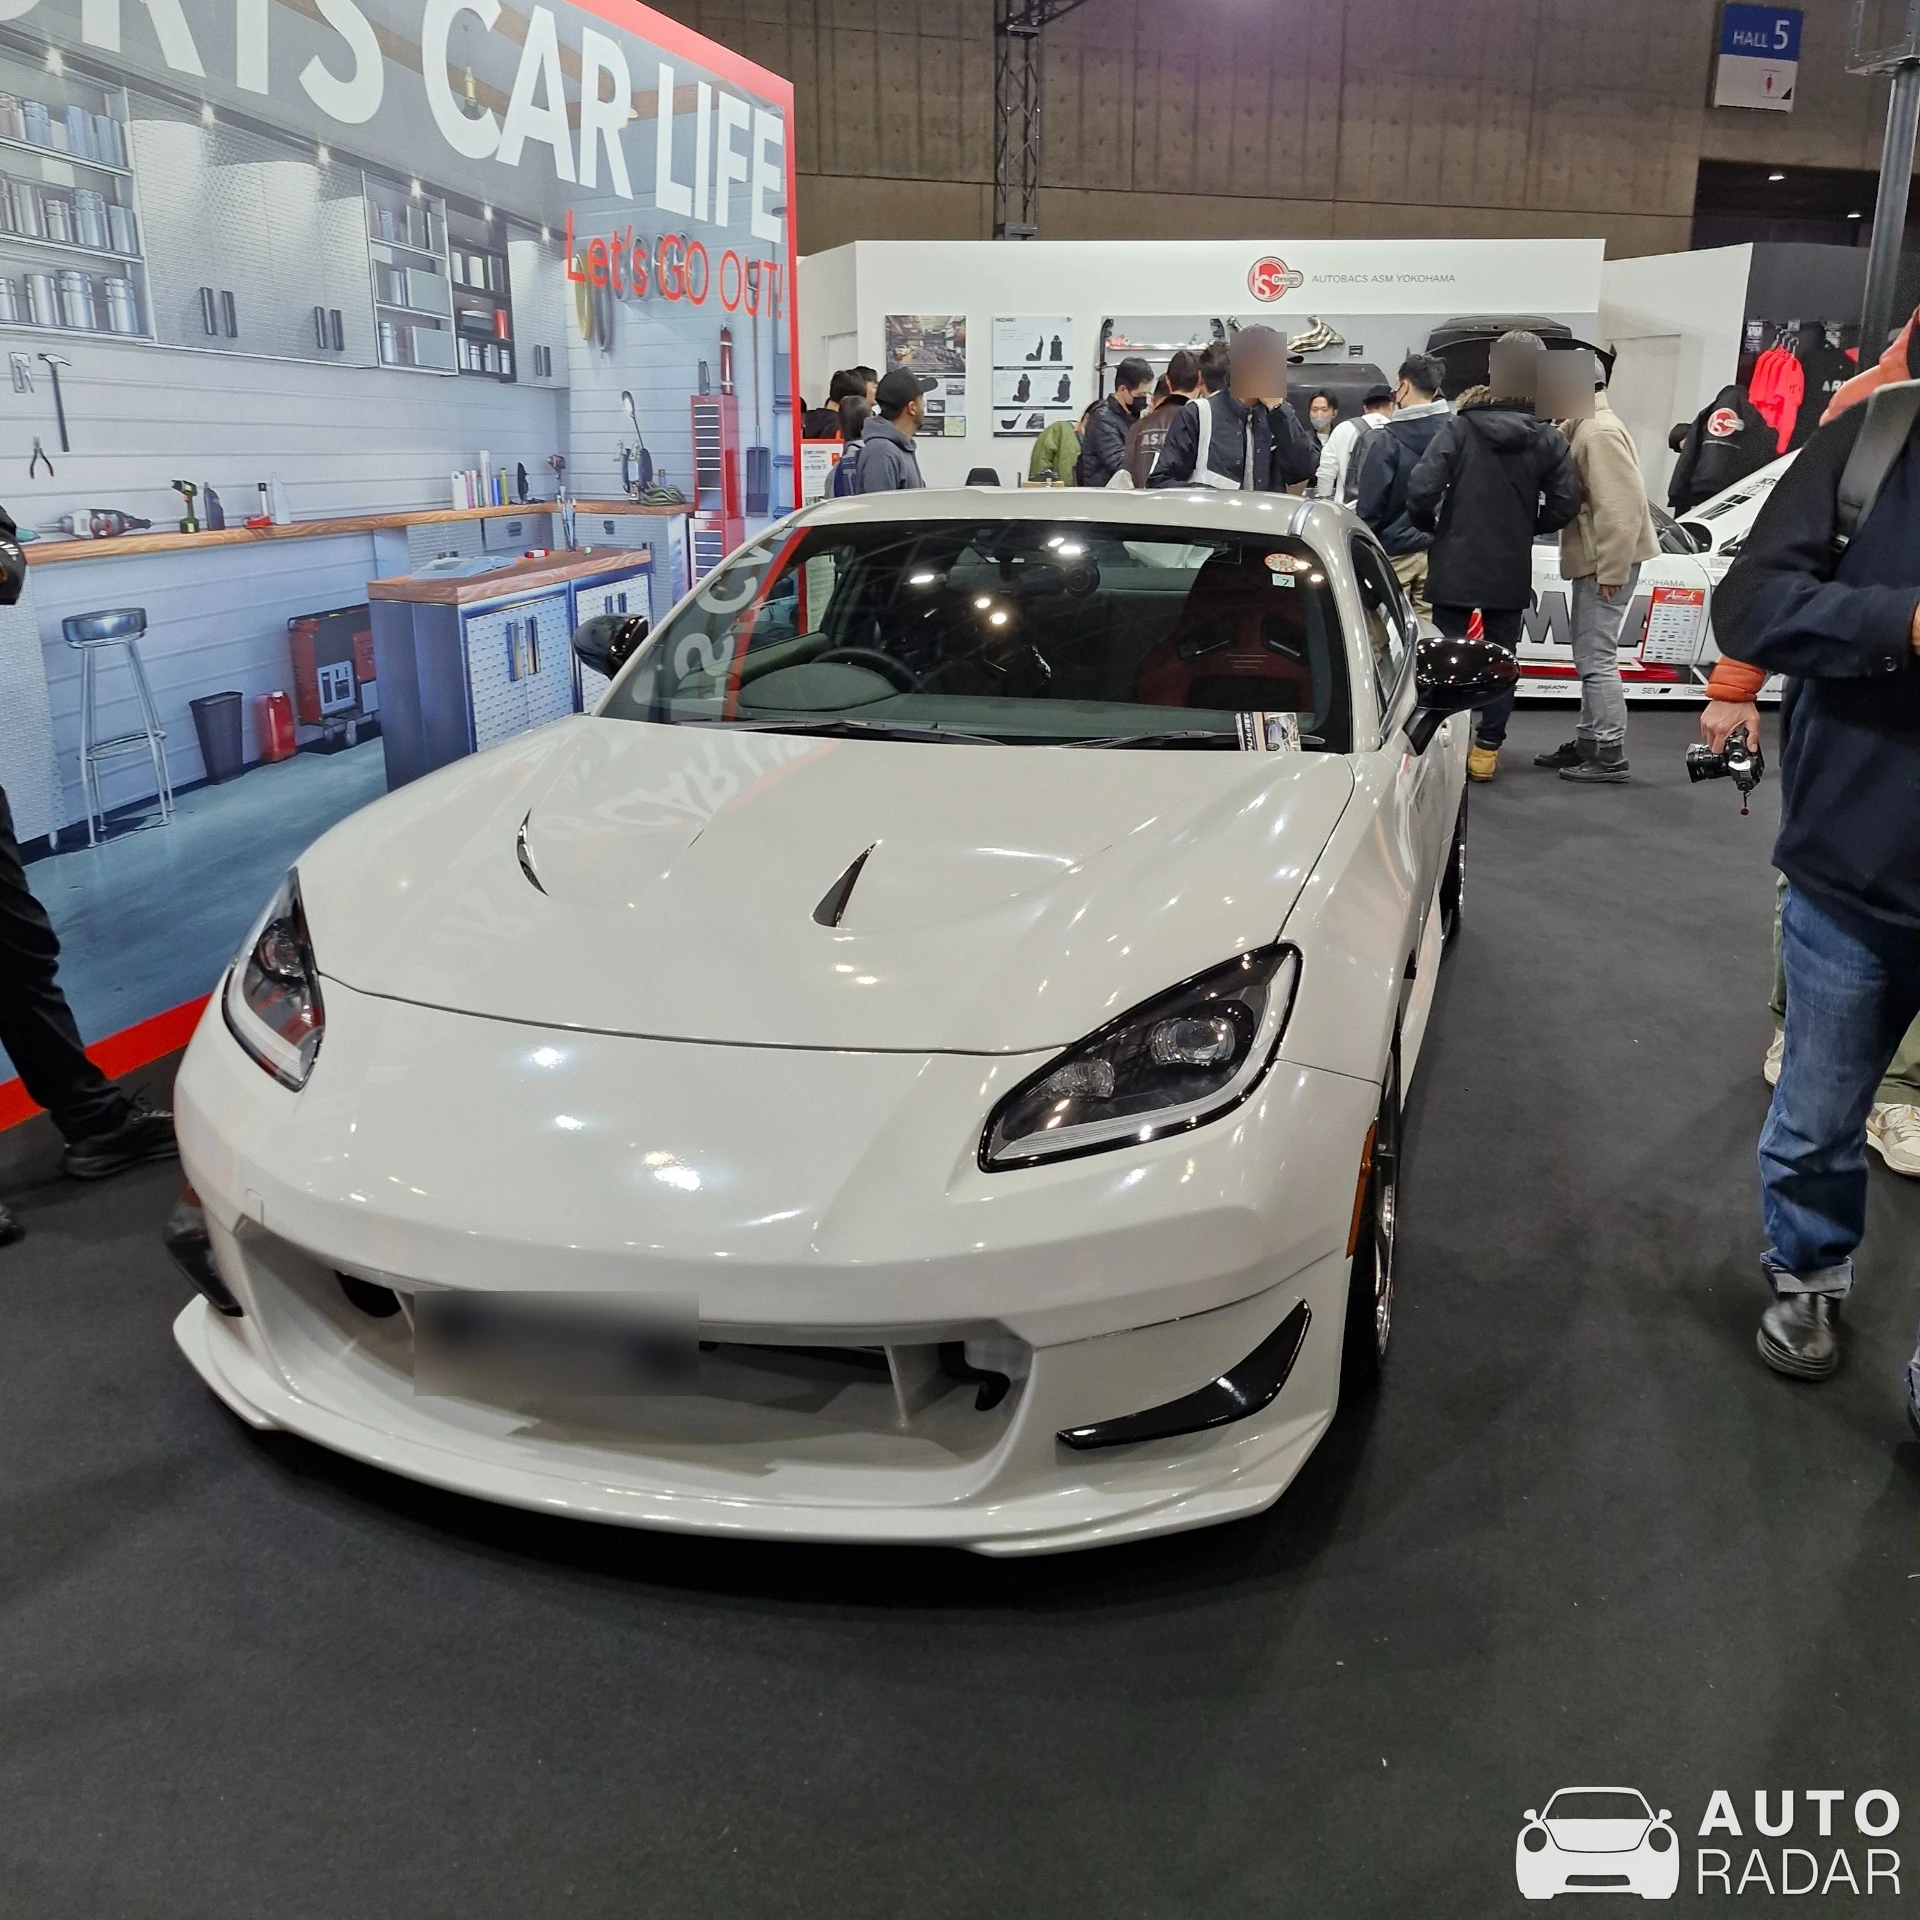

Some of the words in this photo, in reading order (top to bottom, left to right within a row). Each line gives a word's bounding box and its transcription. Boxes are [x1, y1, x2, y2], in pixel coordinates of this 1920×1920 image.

[1732, 31, 1768, 48] HALL
[1773, 19, 1790, 49] 5
[422, 0, 634, 199] CAR
[655, 62, 785, 244] LIFE
[566, 208, 648, 298] Let's
[658, 233, 709, 307] GO
[719, 249, 783, 320] OUT!
[1272, 275, 1299, 286] Design
[1311, 274, 1369, 283] AUTOBACS
[1371, 274, 1394, 283] ASM
[1396, 274, 1456, 283] YOKOHAMA
[1636, 578, 1686, 588] OKOHAMA
